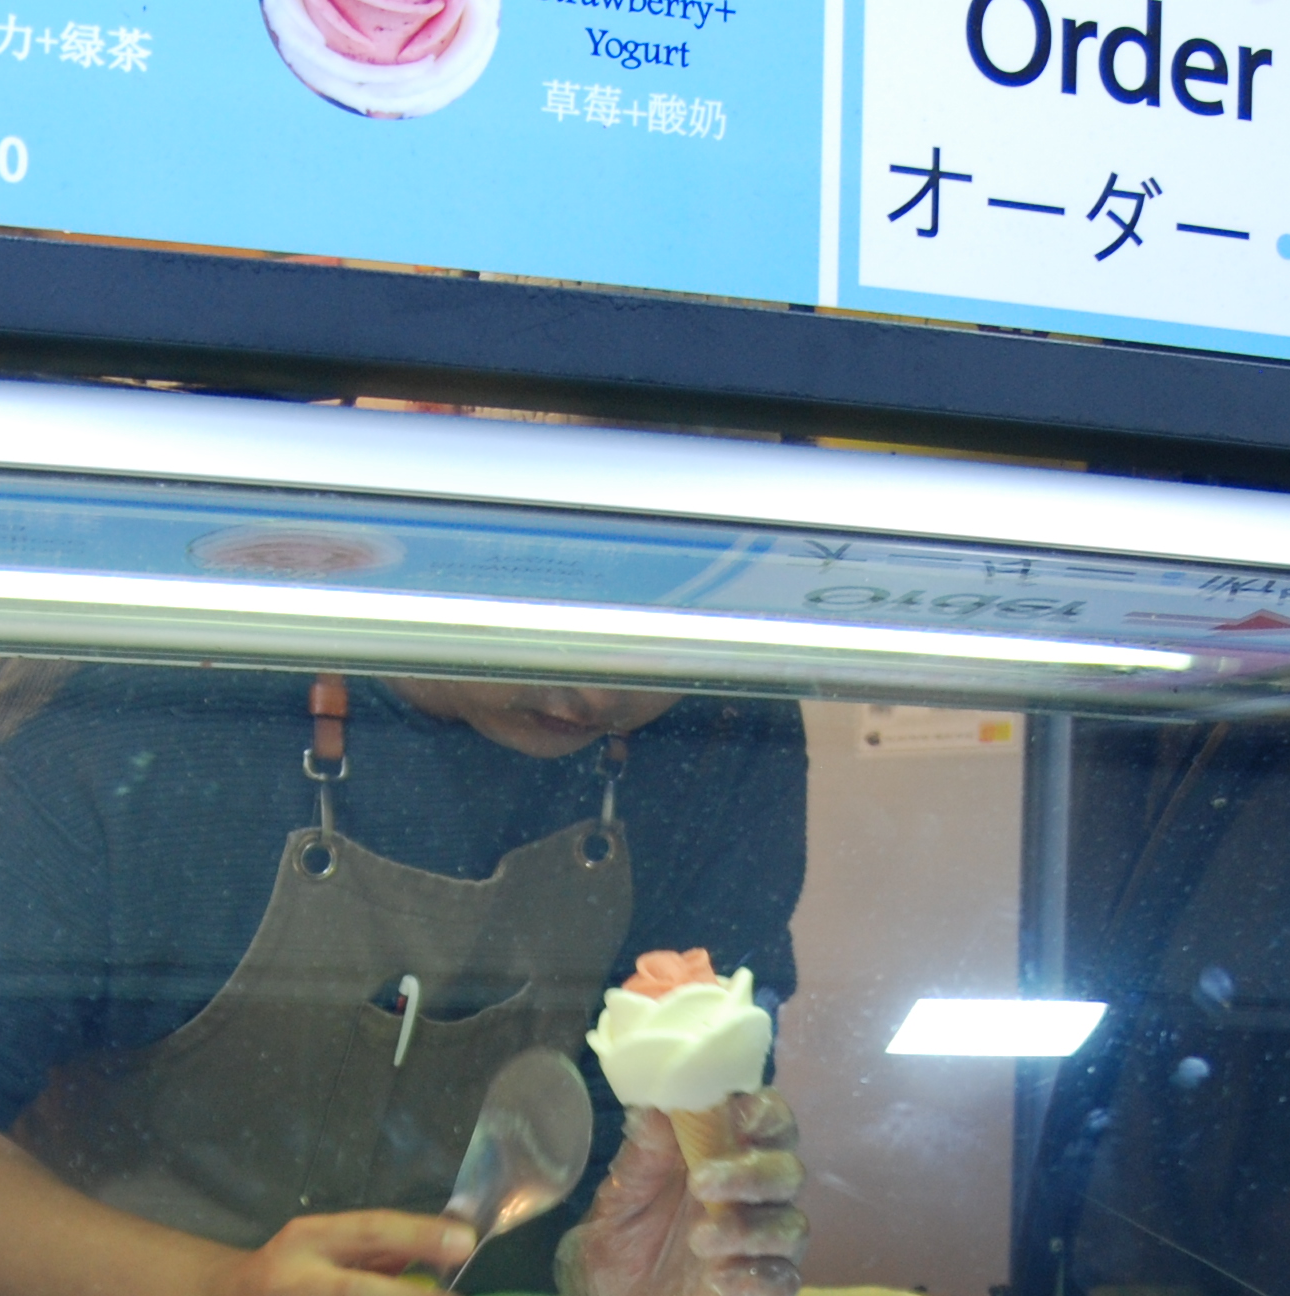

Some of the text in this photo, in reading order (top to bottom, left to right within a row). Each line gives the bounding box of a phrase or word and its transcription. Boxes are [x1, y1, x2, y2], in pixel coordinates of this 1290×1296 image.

[585, 27, 690, 70] Yogurt
[965, 0, 1273, 122] Order
[541, 79, 727, 141] 草莓+酸奶
